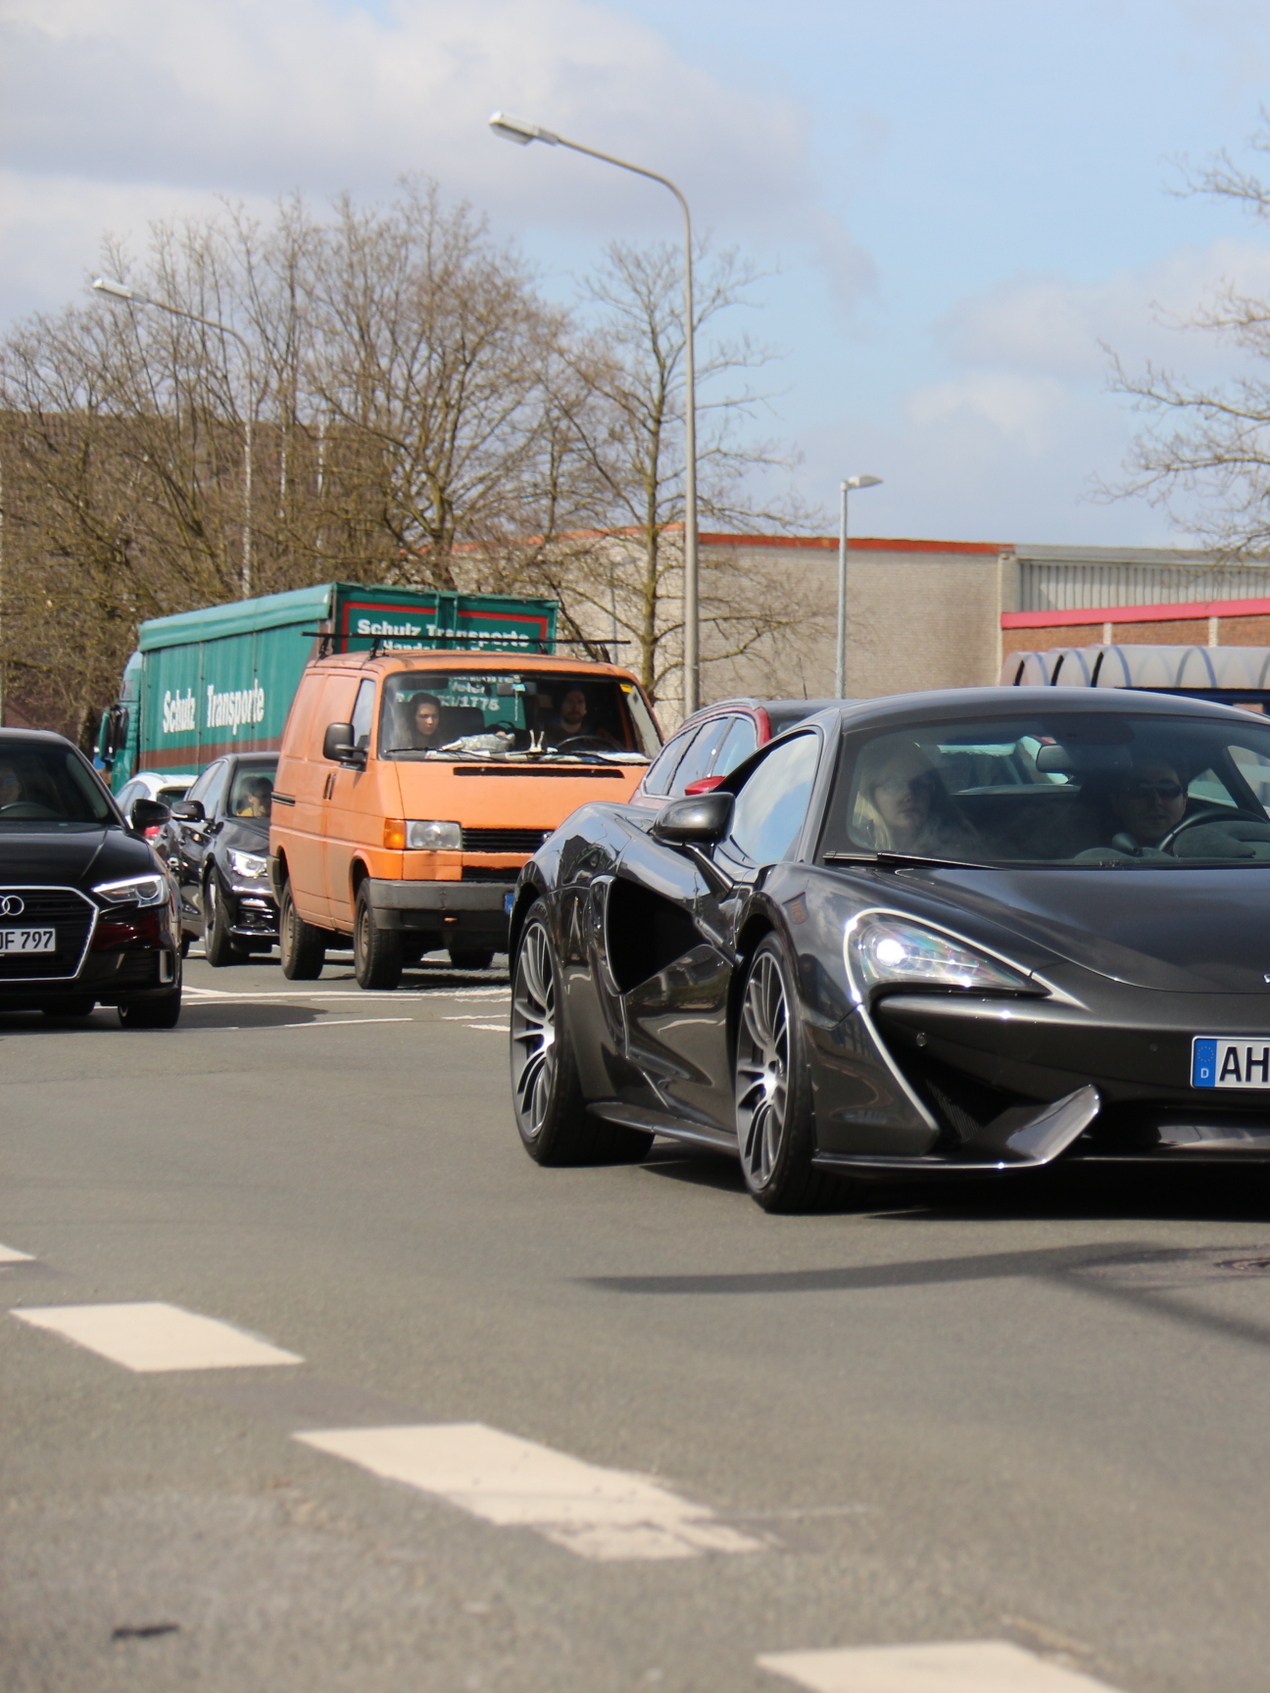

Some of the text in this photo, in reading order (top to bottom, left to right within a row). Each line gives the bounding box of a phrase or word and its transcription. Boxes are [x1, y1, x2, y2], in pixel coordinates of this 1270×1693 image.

[357, 618, 421, 637] Schulz
[163, 678, 265, 736] Schulz Transporte
[20, 930, 54, 950] 797
[1200, 1067, 1209, 1079] D
[1218, 1046, 1270, 1083] AH
